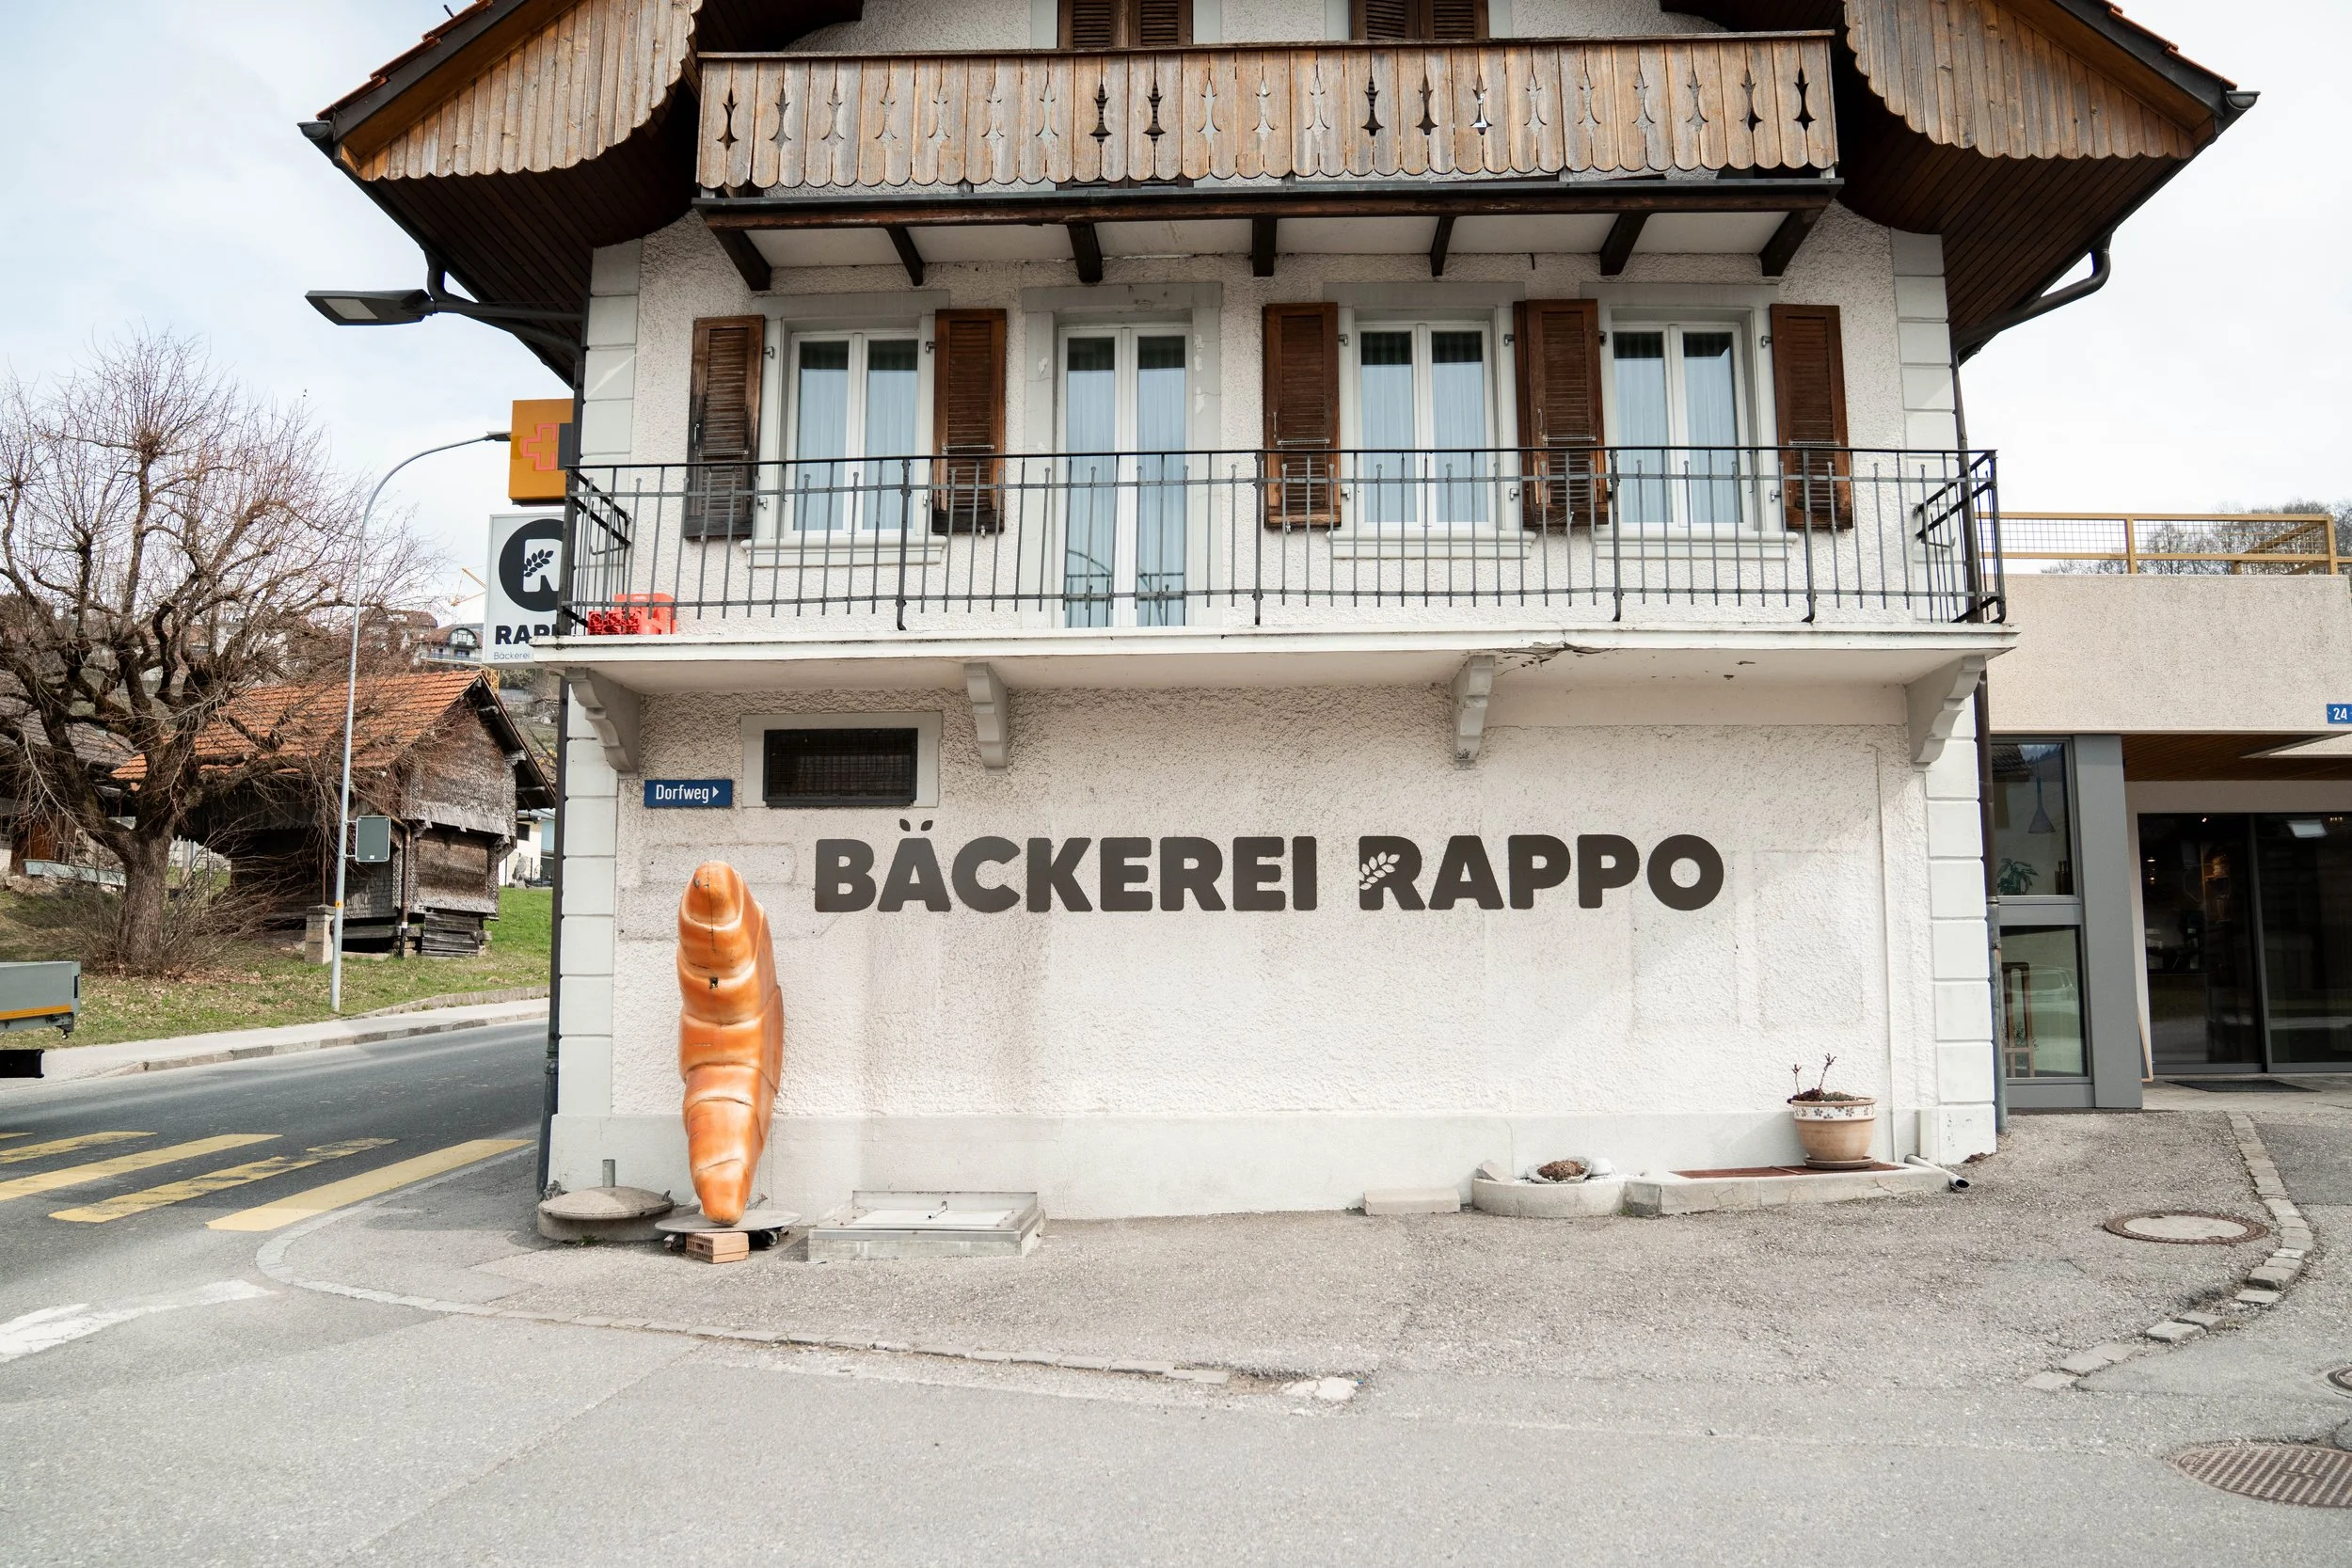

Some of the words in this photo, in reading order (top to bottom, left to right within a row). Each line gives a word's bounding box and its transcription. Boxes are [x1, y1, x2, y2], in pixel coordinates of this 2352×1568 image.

[495, 624, 558, 645] RAP
[2333, 707, 2348, 721] 24
[655, 784, 709, 804] Dorfweg
[815, 818, 1318, 912] BÄCKEREI
[1358, 833, 1725, 911] RAPPO
